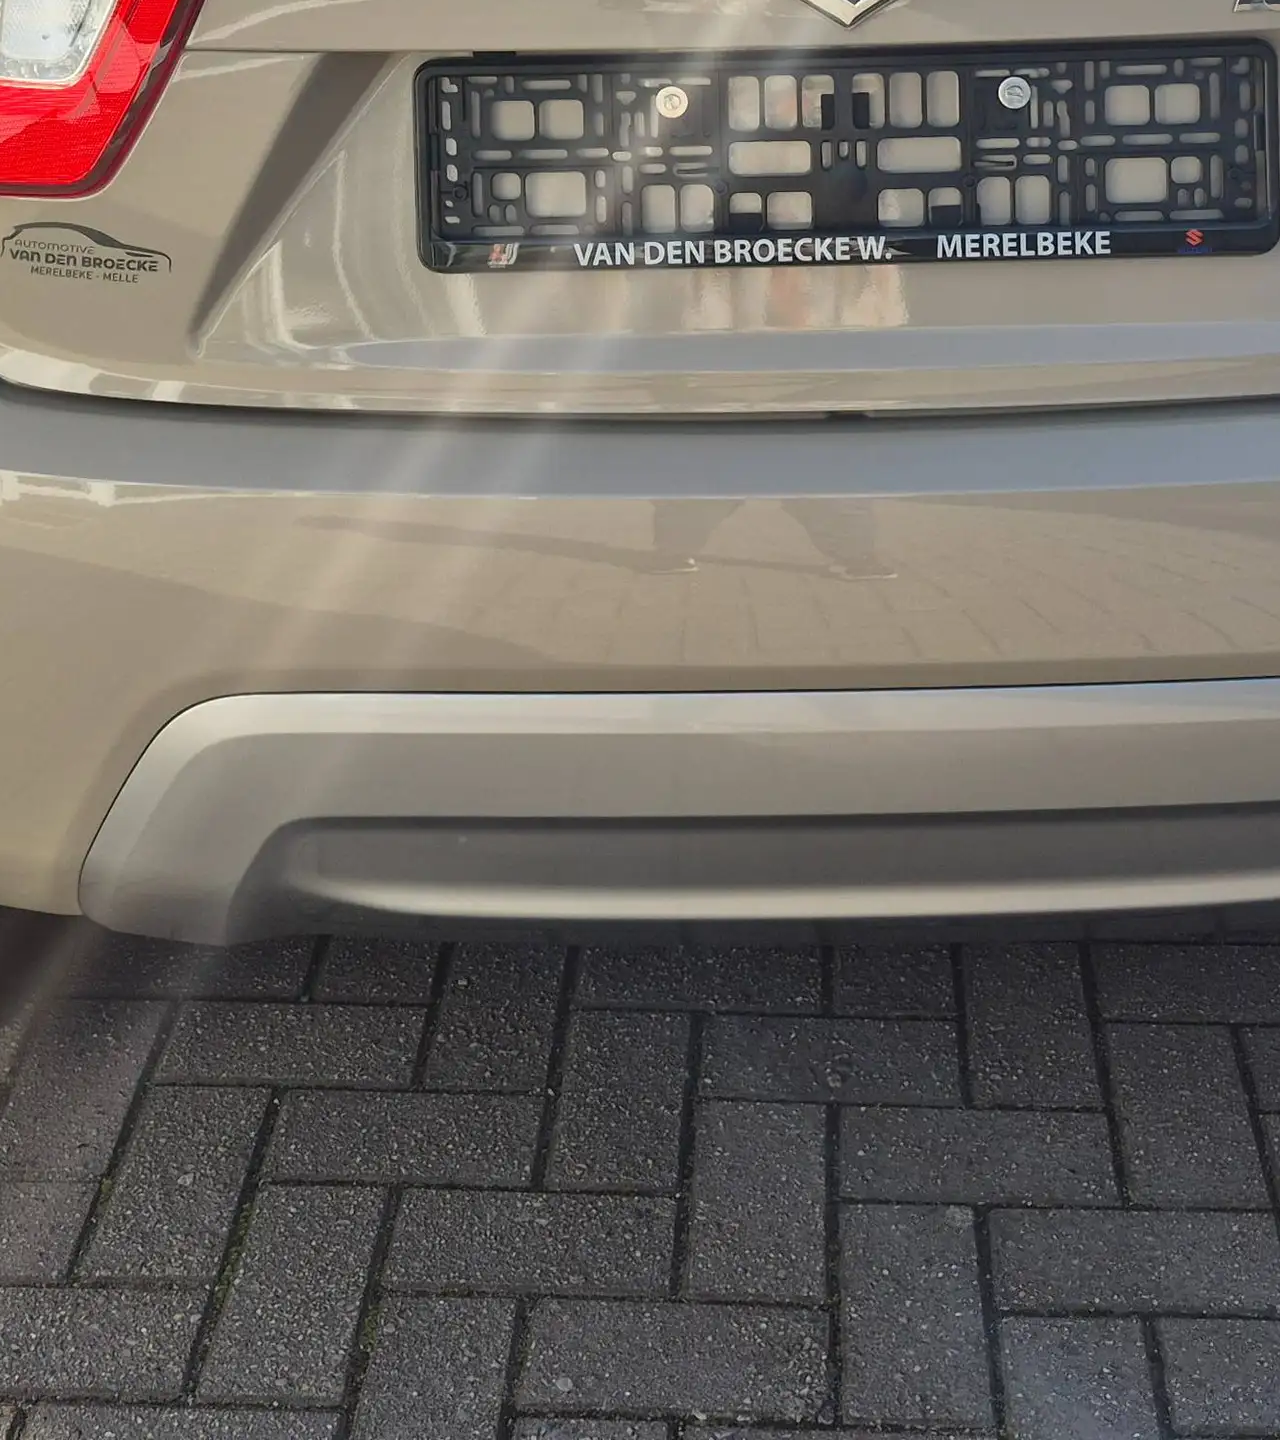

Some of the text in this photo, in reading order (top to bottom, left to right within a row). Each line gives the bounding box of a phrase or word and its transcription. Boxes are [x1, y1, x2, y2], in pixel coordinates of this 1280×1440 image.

[14, 238, 96, 255] AUTOMOTIVE
[574, 230, 1111, 266] VAN DEN BROECKE W. MERELBEKE
[9, 248, 159, 273] VAN DEN BROECKE
[30, 266, 93, 281] MERELBEKE
[102, 272, 139, 284] MELLE
